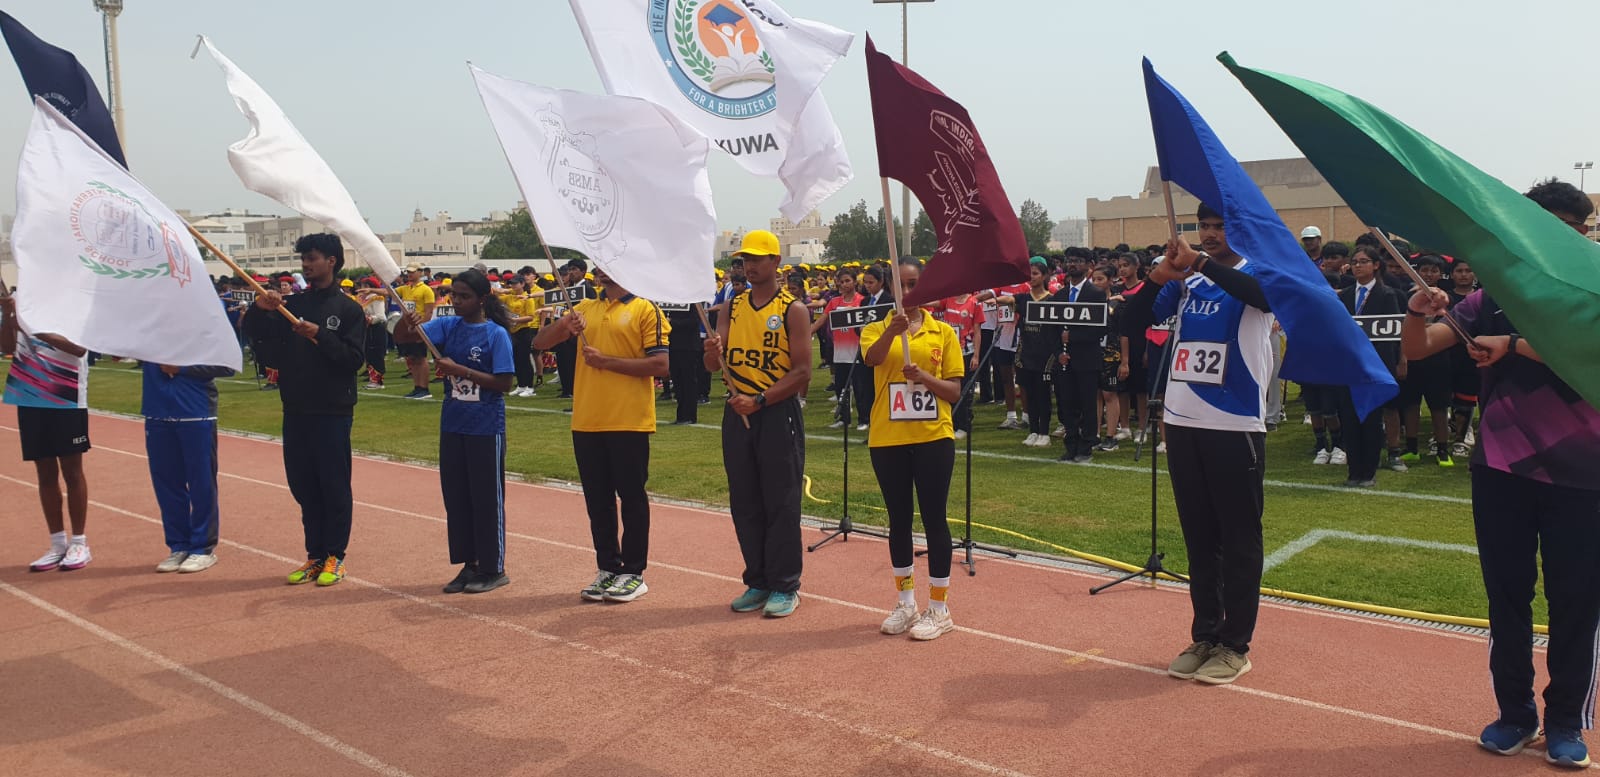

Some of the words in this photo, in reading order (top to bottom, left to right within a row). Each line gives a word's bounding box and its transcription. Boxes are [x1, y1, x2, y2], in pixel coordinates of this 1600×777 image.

[652, 12, 664, 33] THE
[688, 87, 706, 105] FOR
[708, 100, 714, 110] A
[718, 99, 767, 116] BRIGHTER
[552, 289, 577, 302] AIS
[847, 309, 877, 324] IES
[1039, 306, 1092, 320] ILOA
[763, 331, 780, 348] 21
[728, 347, 780, 371] CSK
[1174, 348, 1190, 372] R
[1193, 349, 1222, 375] 32
[892, 390, 906, 412] A
[911, 390, 936, 412] 62
